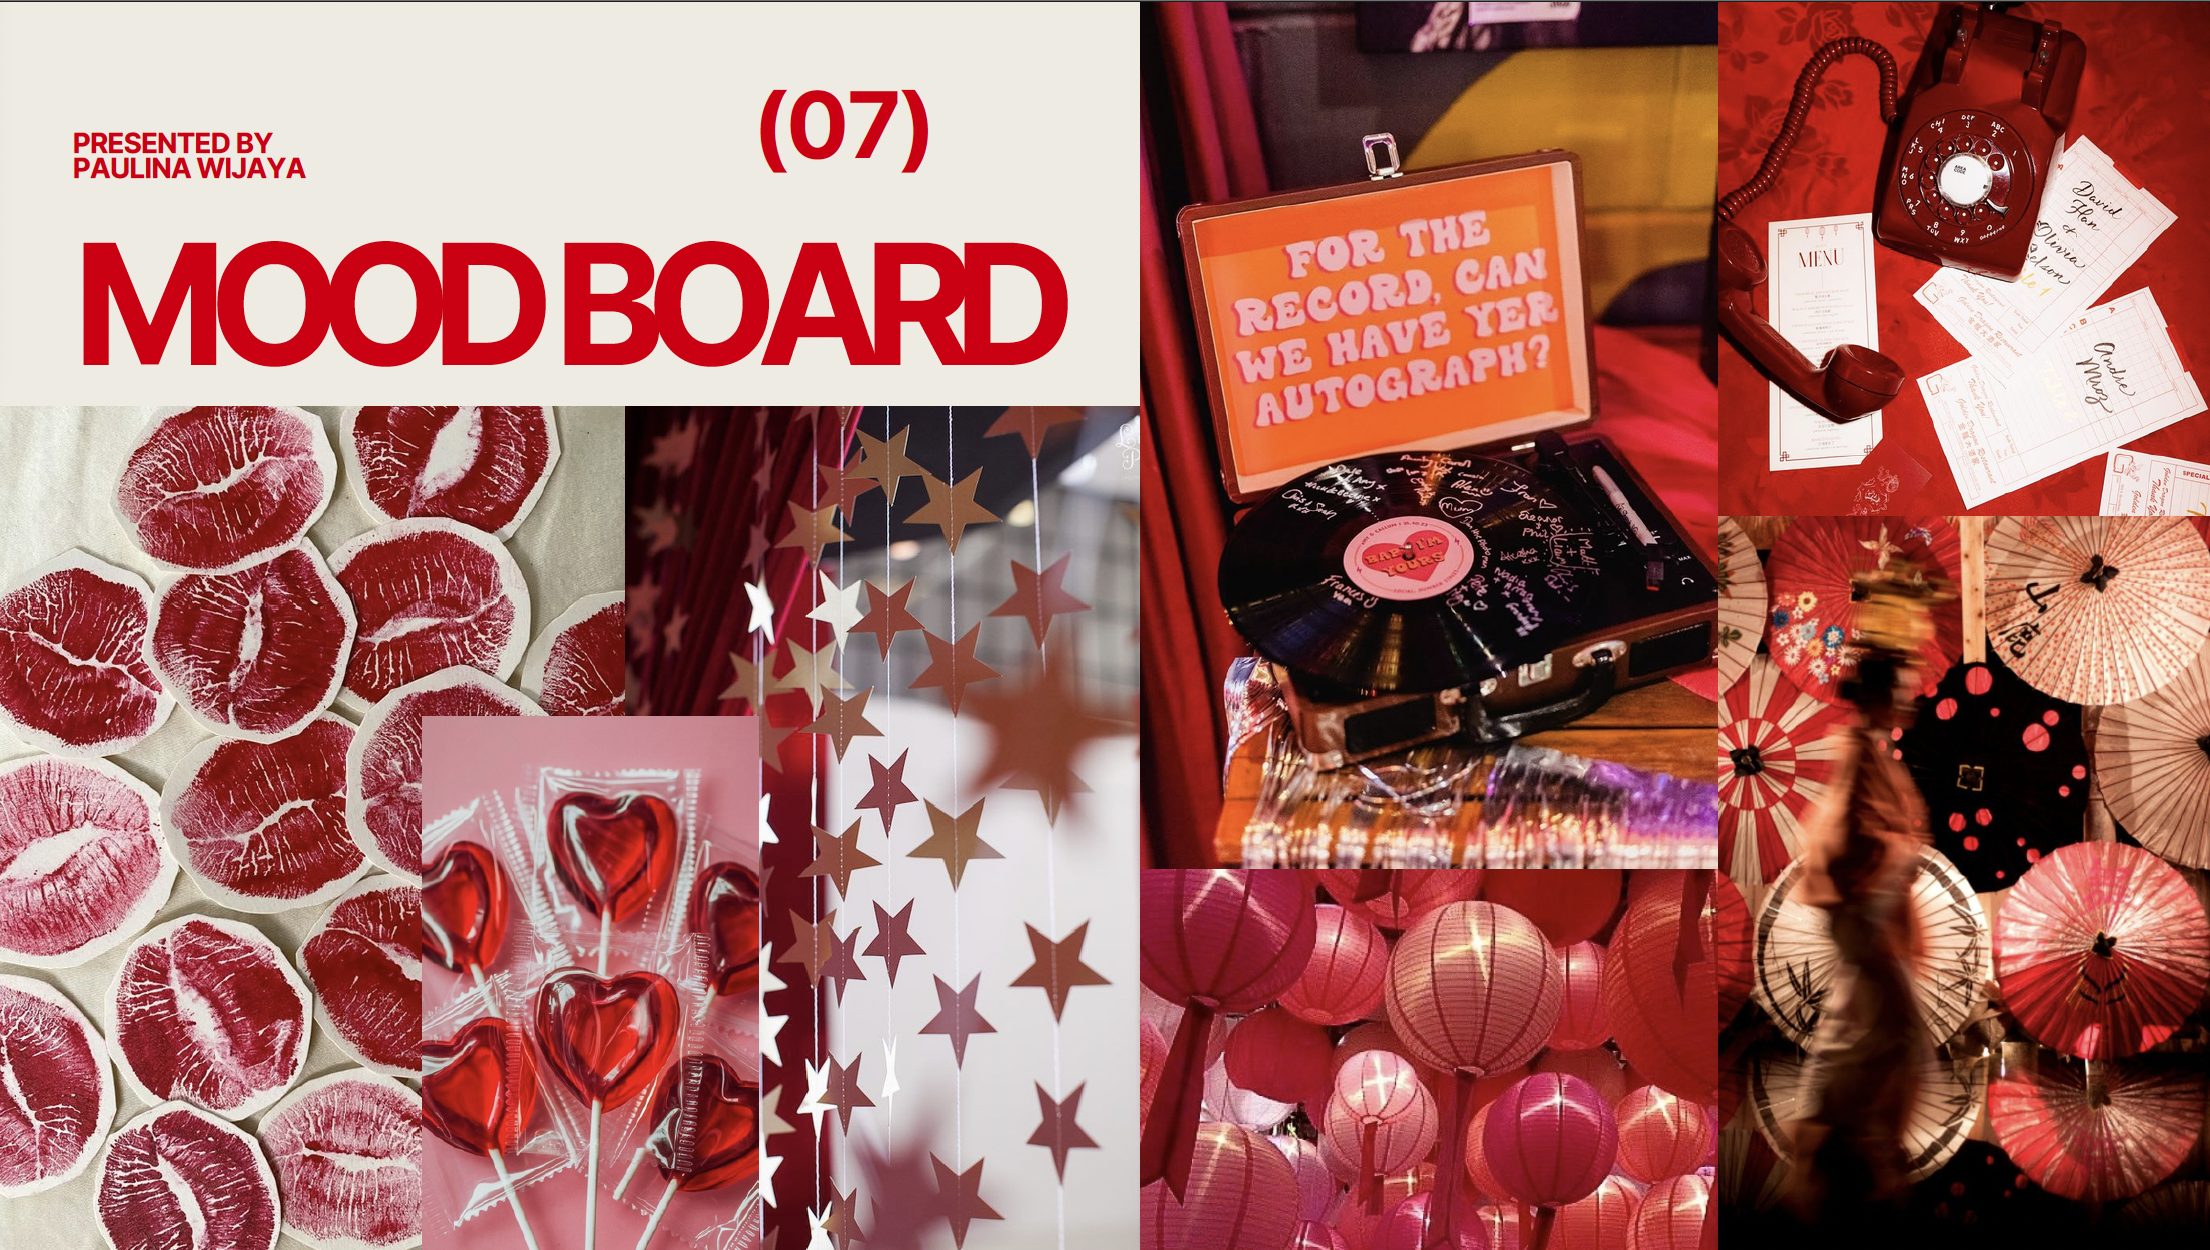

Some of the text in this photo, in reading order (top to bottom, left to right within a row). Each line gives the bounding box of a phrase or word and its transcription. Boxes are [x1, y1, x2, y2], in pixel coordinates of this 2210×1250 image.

[1991, 121, 2005, 133] ABC
[2072, 180, 2122, 220] David
[1284, 211, 1490, 280] FOR THE
[1799, 247, 1844, 268] MENU
[1232, 247, 1548, 337] RECORD, CAN
[1974, 310, 1995, 332] Dragon
[2108, 306, 2116, 314] A
[2079, 318, 2087, 326] B
[1232, 291, 1559, 384] WE HAVE YER
[1253, 334, 1551, 428] AUTOGRAPH?
[1968, 377, 1980, 401] Thank
[1955, 398, 1997, 485] Golden Dragon Restaurant
[1451, 480, 1478, 493] Alex
[2182, 470, 2210, 481] SPECIAL
[2131, 490, 2142, 514] Golden
[2150, 479, 2161, 504] Thank
[1441, 502, 1473, 513] Mum
[1415, 536, 1443, 550] I'M
[1522, 527, 1549, 539] Phil
[1381, 551, 1446, 577] YOURS
